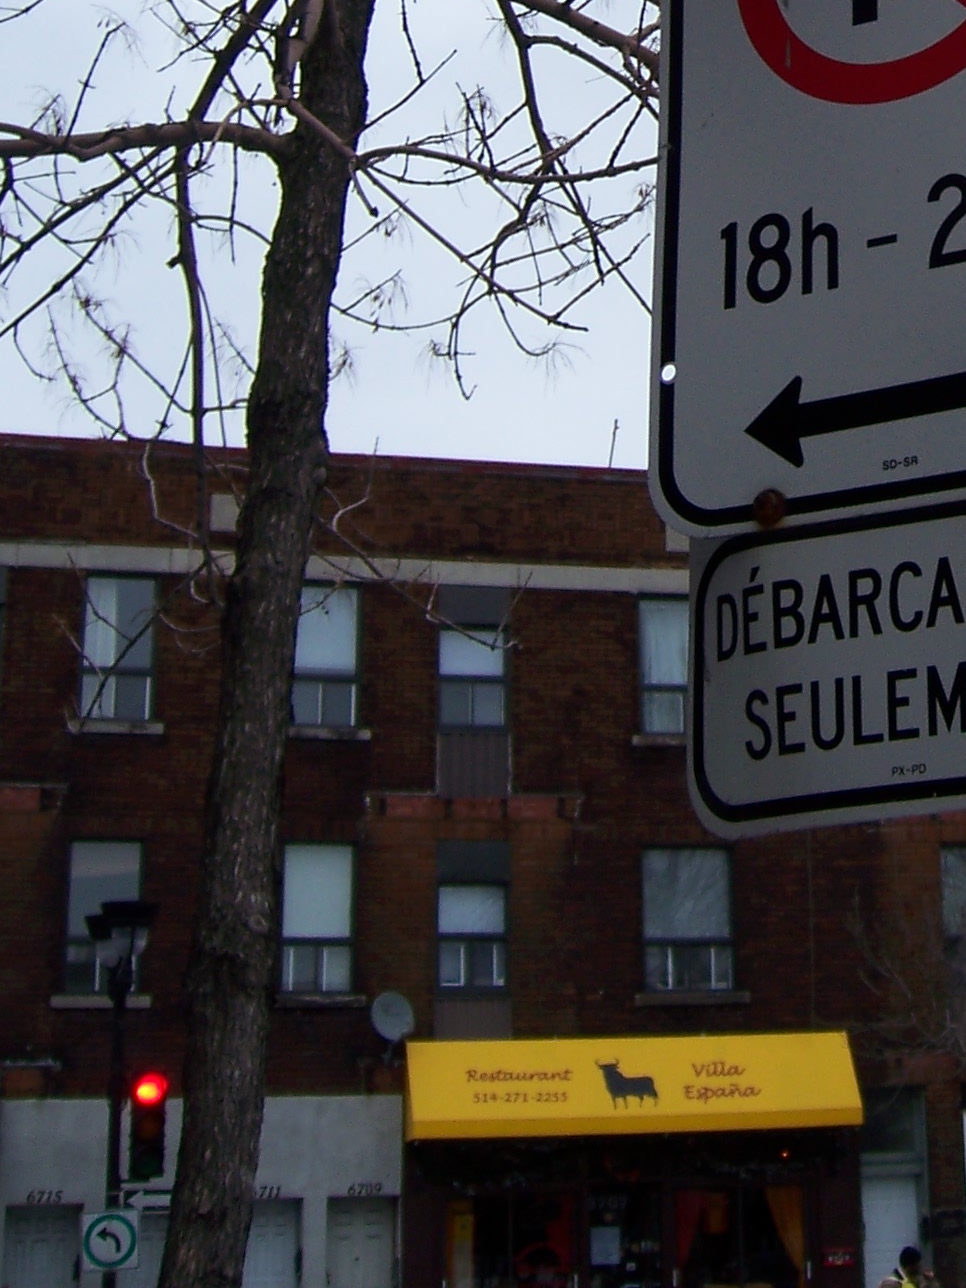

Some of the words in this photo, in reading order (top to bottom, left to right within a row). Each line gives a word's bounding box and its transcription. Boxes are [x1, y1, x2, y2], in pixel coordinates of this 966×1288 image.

[720, 207, 839, 311] 18h
[465, 1067, 573, 1084] Restaurant
[691, 1060, 746, 1079] Villa
[683, 1083, 761, 1106] España
[26, 1189, 64, 1205] 6715
